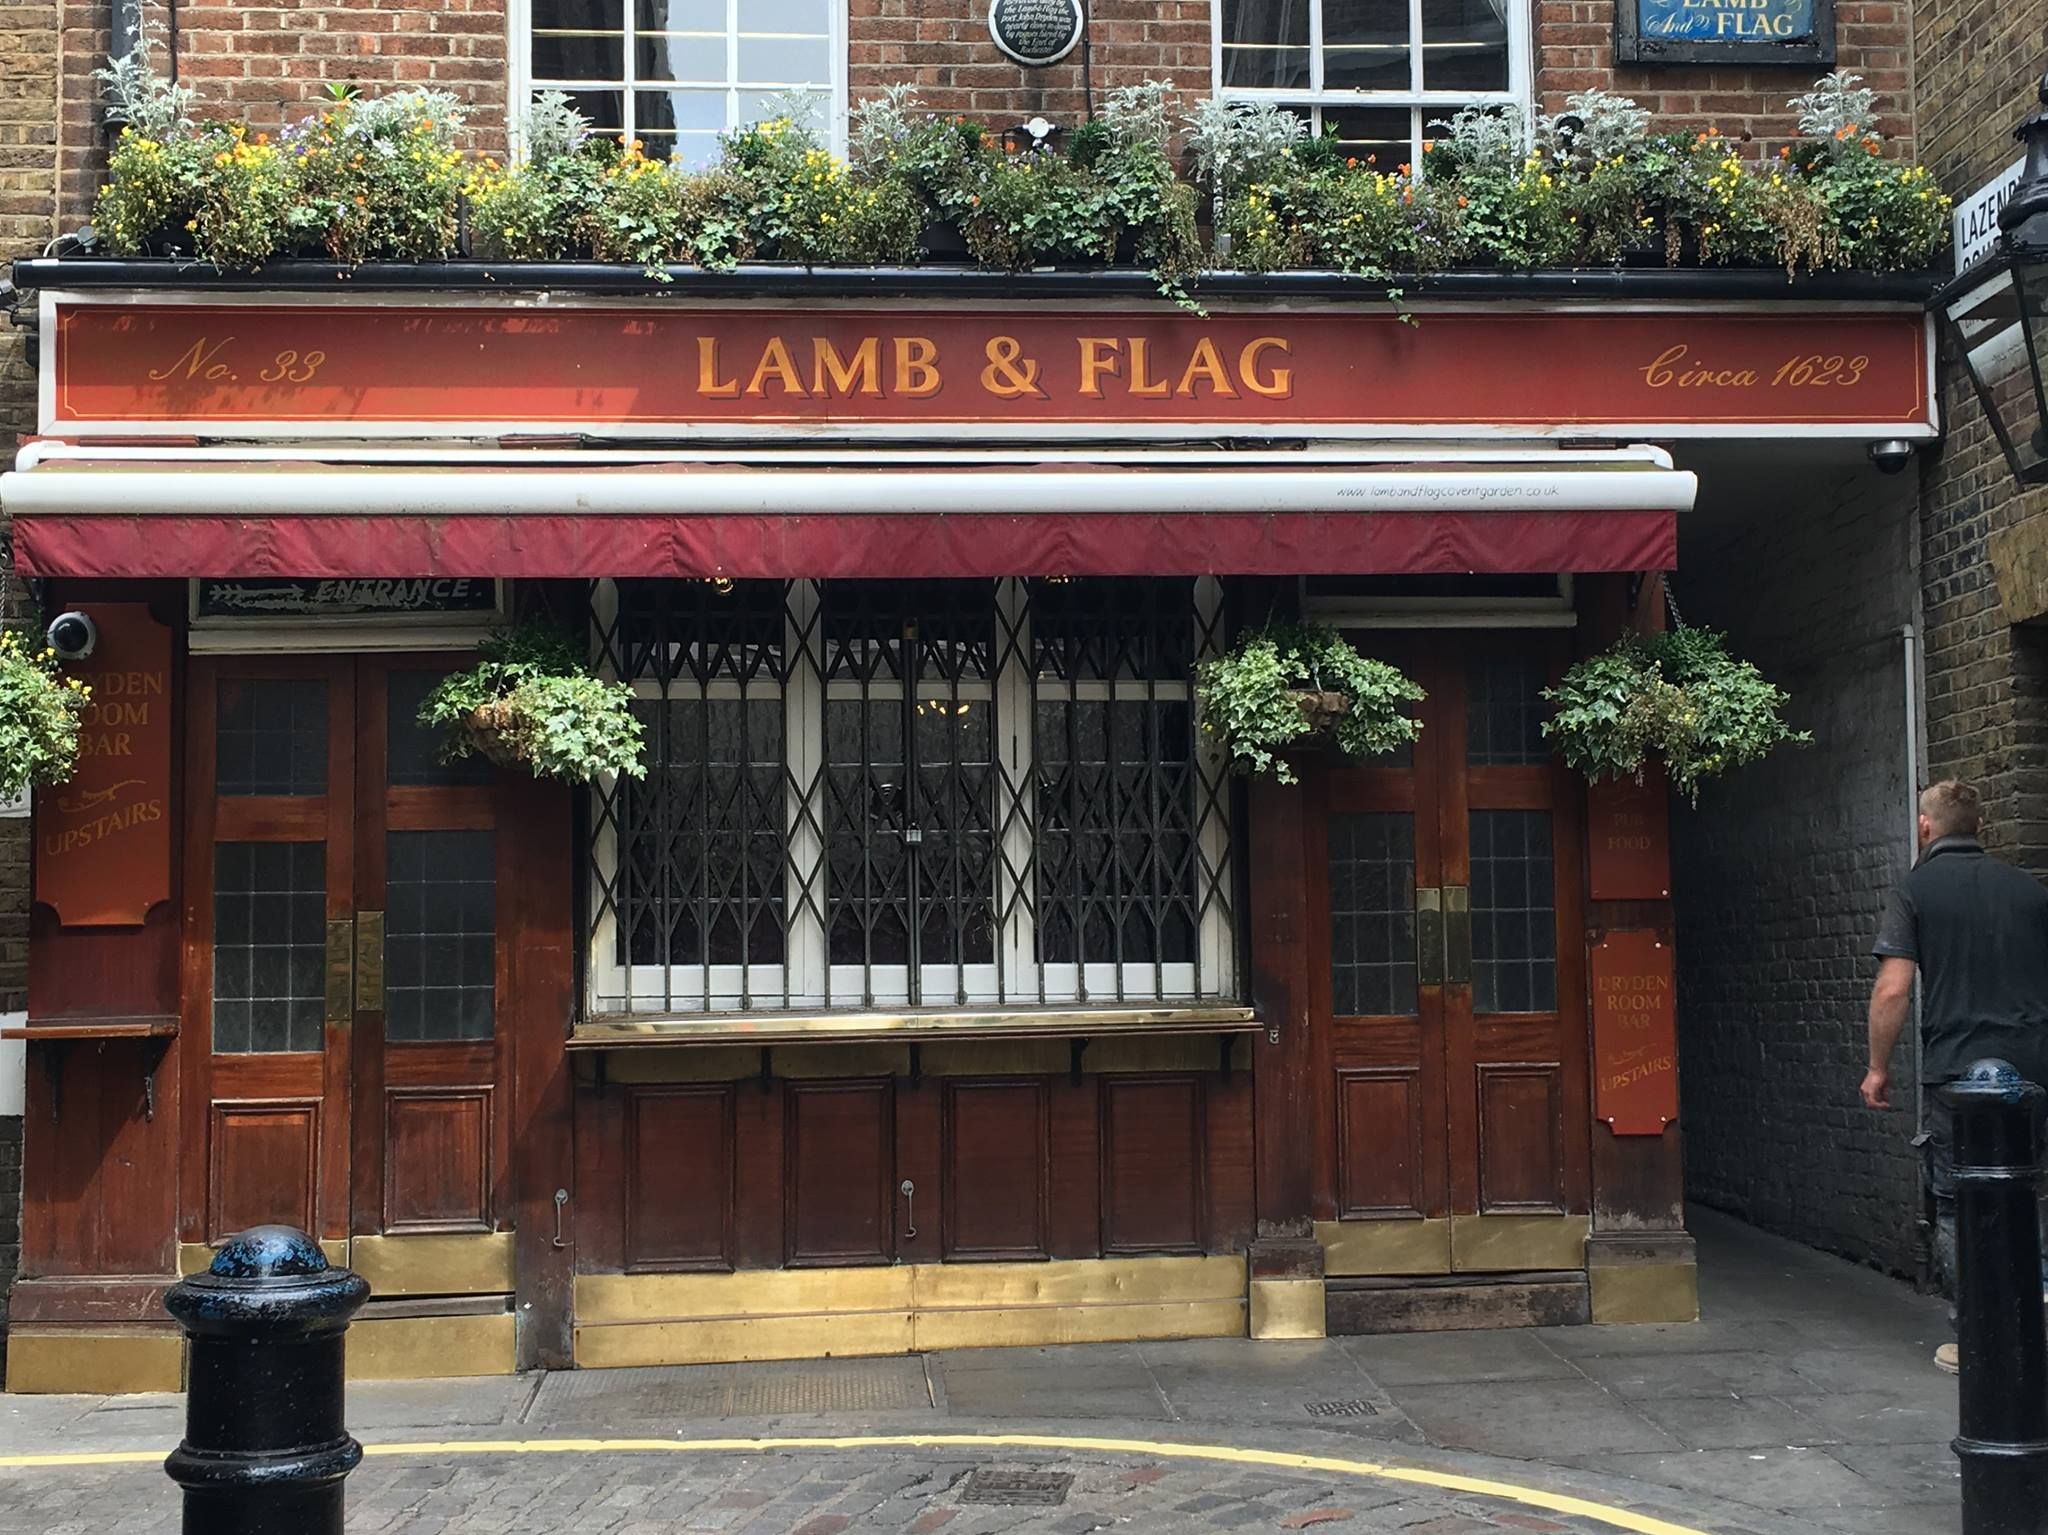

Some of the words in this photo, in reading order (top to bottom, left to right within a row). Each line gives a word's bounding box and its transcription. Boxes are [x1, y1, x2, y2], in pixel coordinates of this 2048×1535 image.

[1646, 12, 1707, 33] And
[1716, 12, 1793, 35] FLAG
[1961, 175, 2021, 249] LAZEN
[149, 336, 236, 381] No.
[260, 350, 326, 382] 33
[696, 336, 942, 397] LAMB
[980, 336, 1046, 397] &
[1077, 336, 1297, 397] FLAG
[1638, 344, 1759, 388] Circa
[1771, 354, 1869, 387] 1623
[80, 702, 150, 726] OOM
[78, 732, 132, 756] BAR
[46, 799, 162, 856] UPSTAIRS
[1607, 836, 1651, 850] FOOD
[1598, 975, 1668, 991] DRYDEN
[1607, 994, 1661, 1010] ROOM
[1618, 1013, 1651, 1029] BAR
[1601, 1055, 1672, 1092] UPSTAIRS
